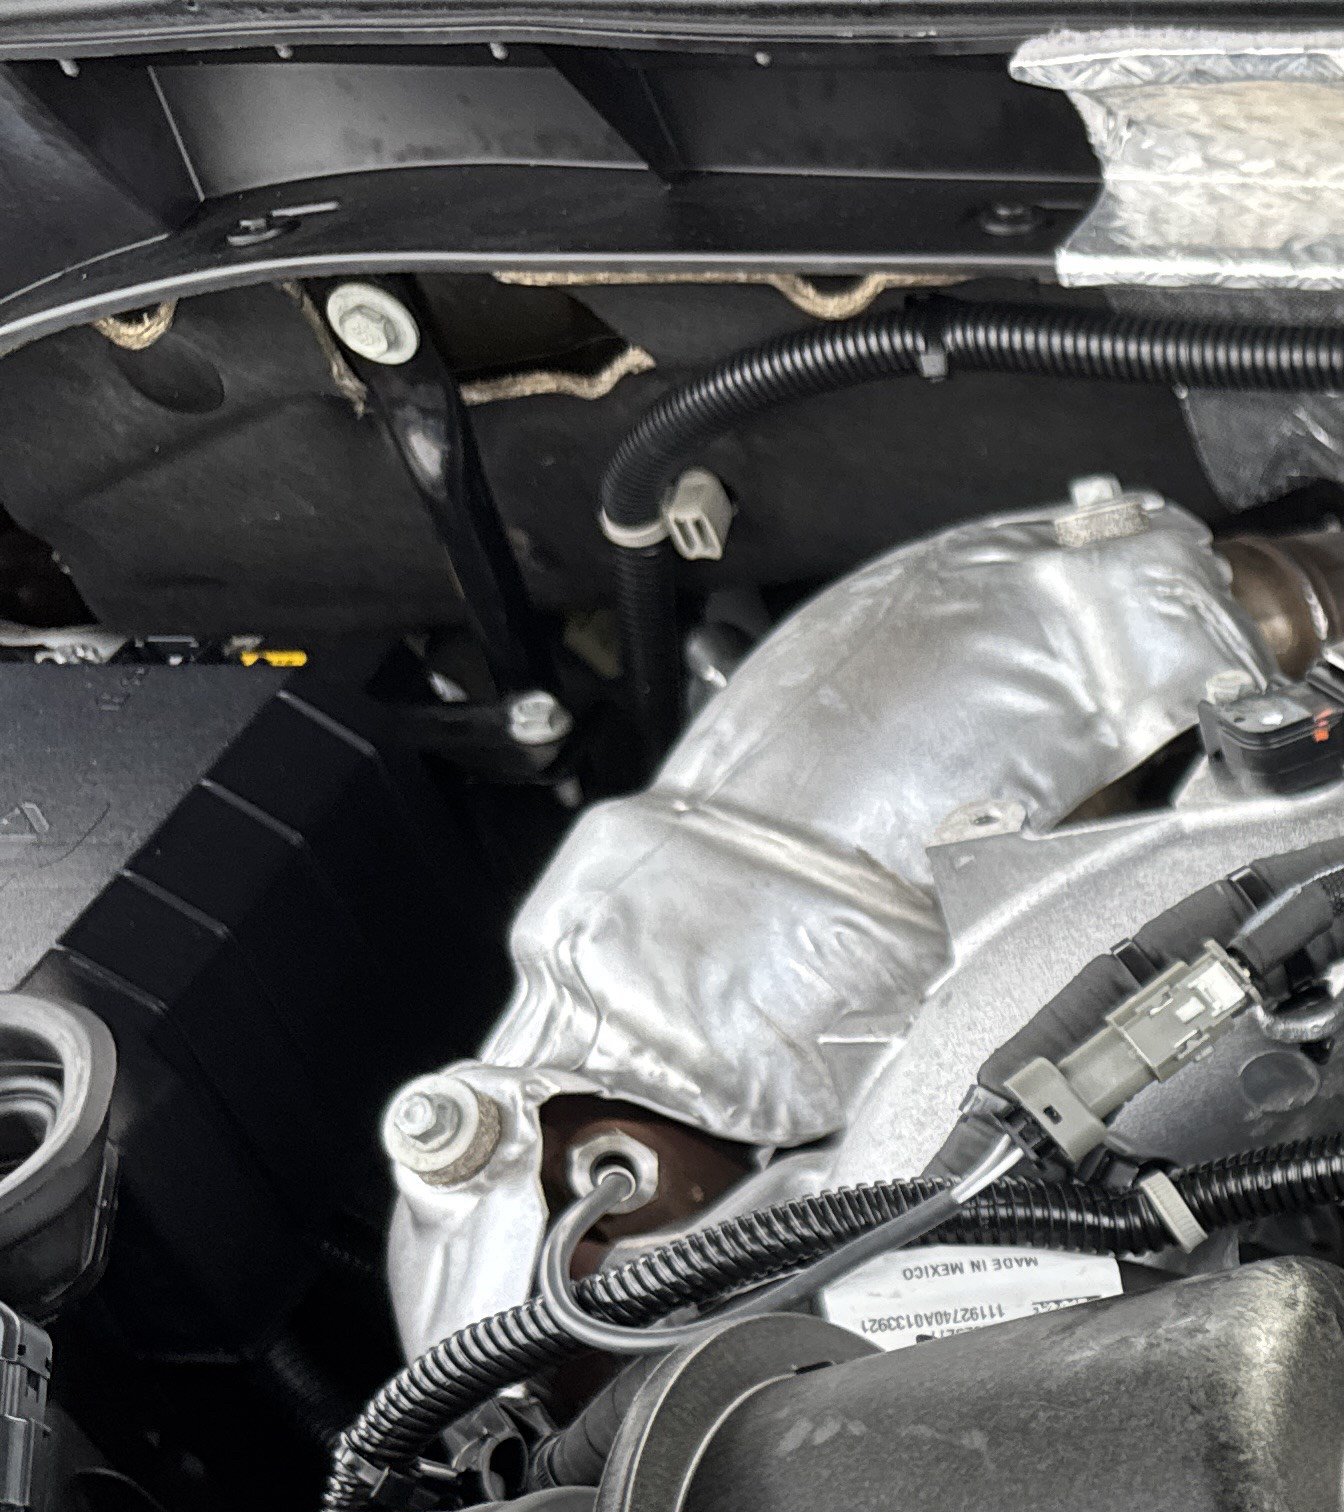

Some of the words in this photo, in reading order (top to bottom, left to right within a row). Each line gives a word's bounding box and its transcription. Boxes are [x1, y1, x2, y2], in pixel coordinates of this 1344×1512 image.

[901, 1259, 965, 1282] MEXICO
[970, 1259, 988, 1273] IN
[993, 1255, 1039, 1272] MADE
